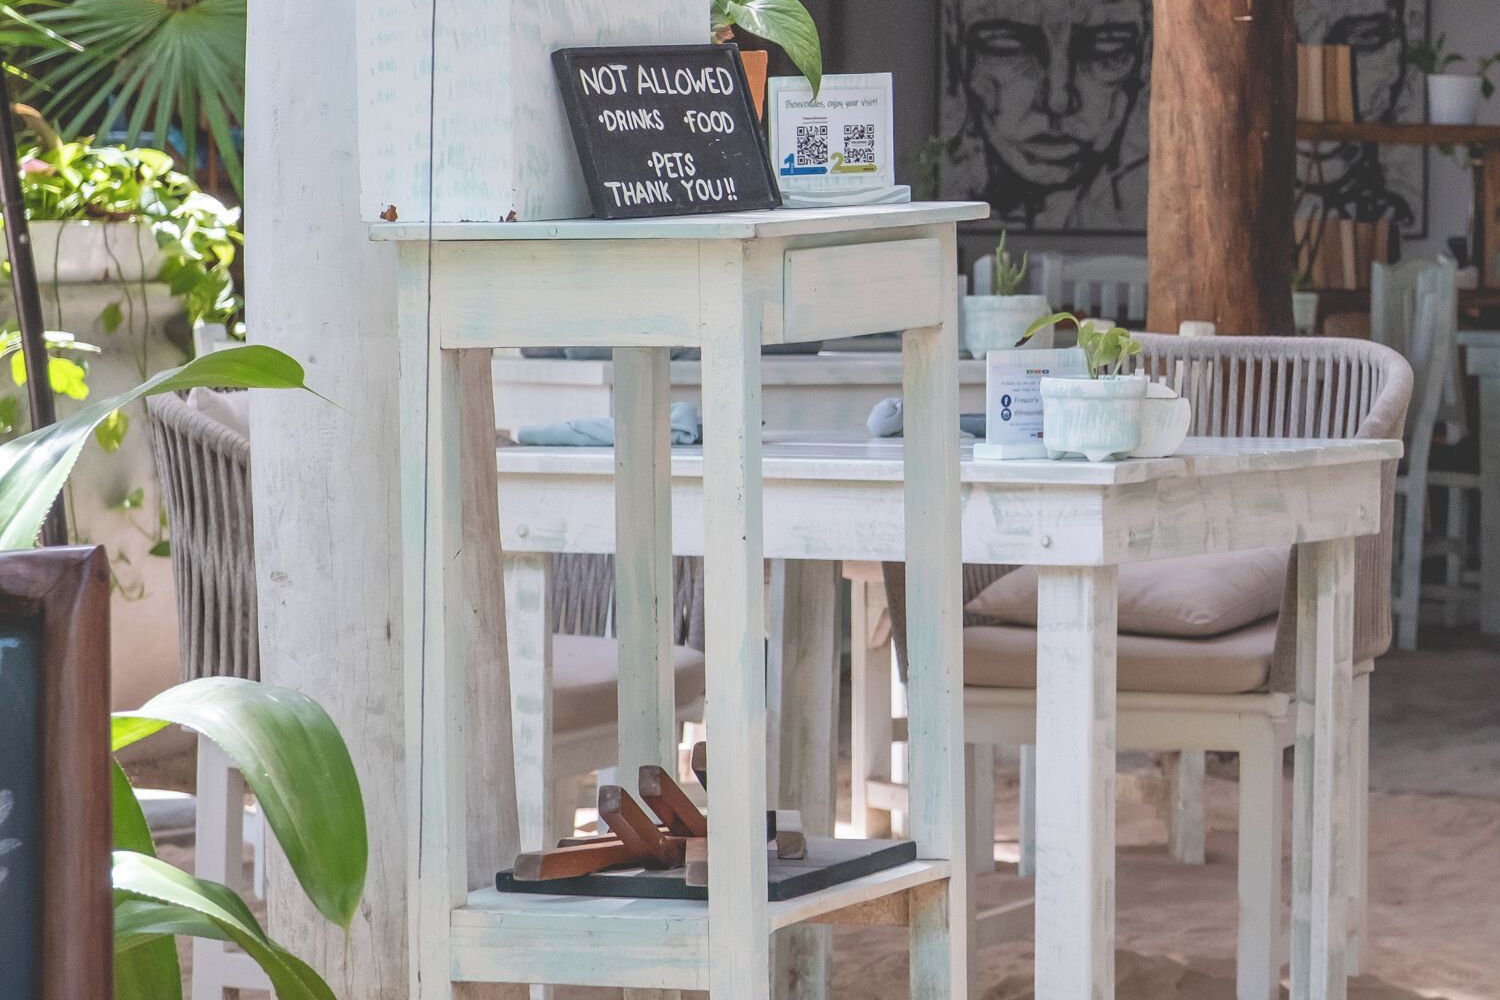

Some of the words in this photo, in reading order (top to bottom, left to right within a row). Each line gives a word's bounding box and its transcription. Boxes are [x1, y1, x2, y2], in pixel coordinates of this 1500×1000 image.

[579, 64, 628, 96] NOT
[637, 64, 734, 96] ALLOWED
[603, 179, 673, 208] THANK
